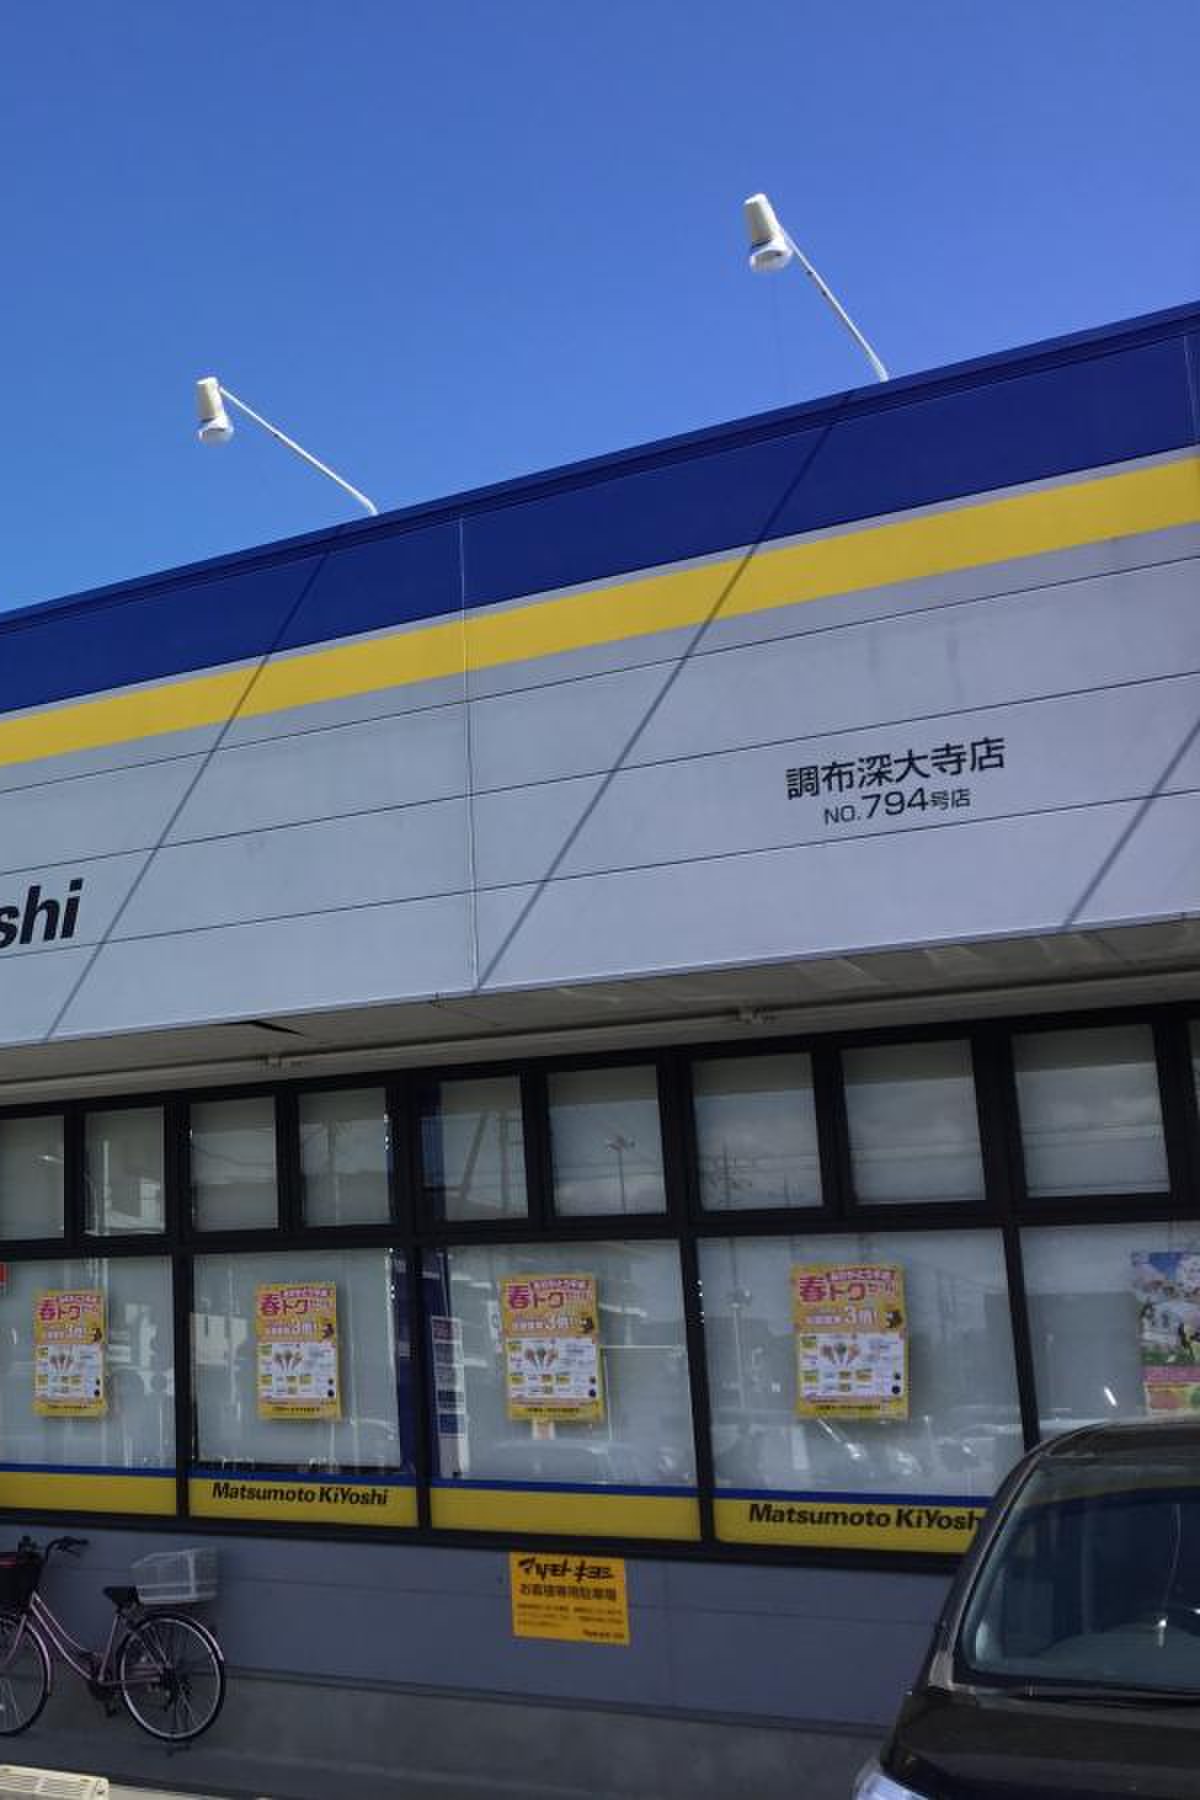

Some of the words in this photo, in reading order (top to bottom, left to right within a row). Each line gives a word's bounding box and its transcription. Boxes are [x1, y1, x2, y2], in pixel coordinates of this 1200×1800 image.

[786, 737, 1005, 800] 調布深大寺店
[212, 1482, 316, 1503] Matsumoto
[319, 1486, 388, 1505] KiYoshi
[749, 1503, 890, 1528] Matsumoto
[518, 1557, 615, 1583] マツモトキヨシ
